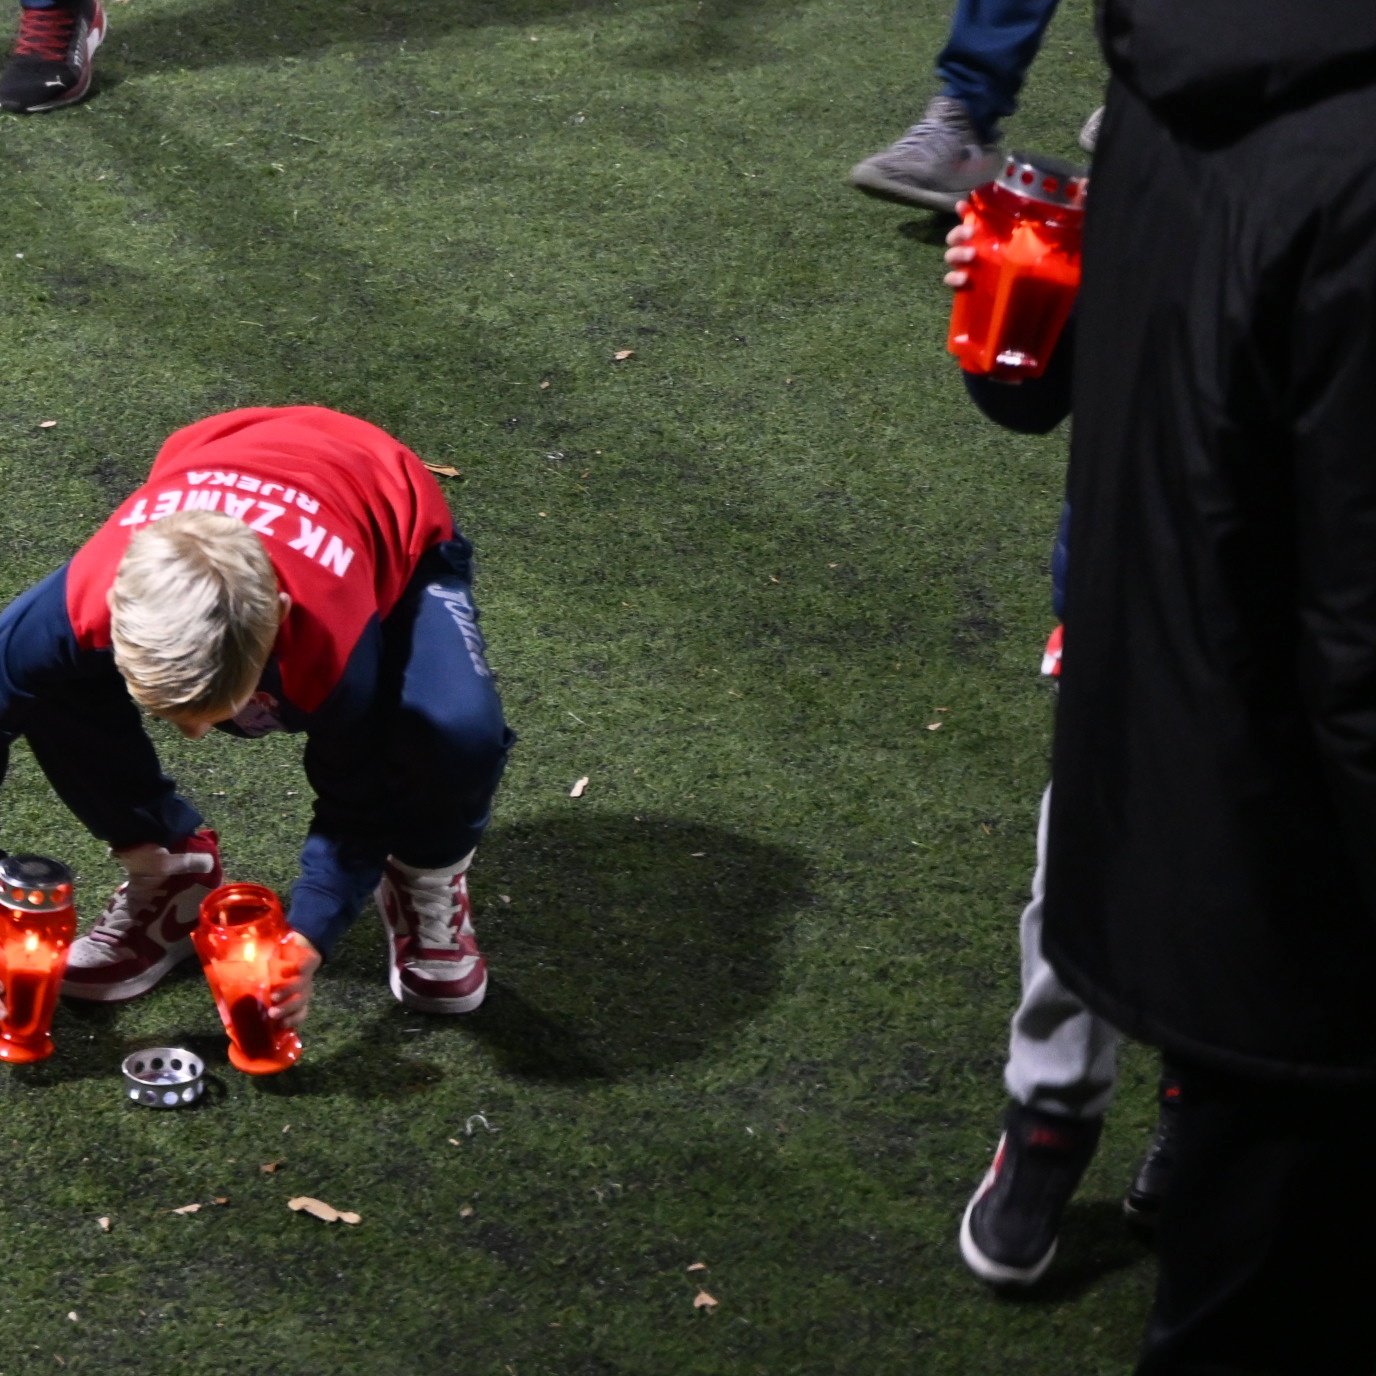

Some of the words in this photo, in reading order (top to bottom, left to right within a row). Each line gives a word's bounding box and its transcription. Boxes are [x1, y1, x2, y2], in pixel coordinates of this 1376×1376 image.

[120, 489, 287, 537] ZAMET
[186, 471, 320, 515] RIJEKA
[287, 516, 355, 578] NK
